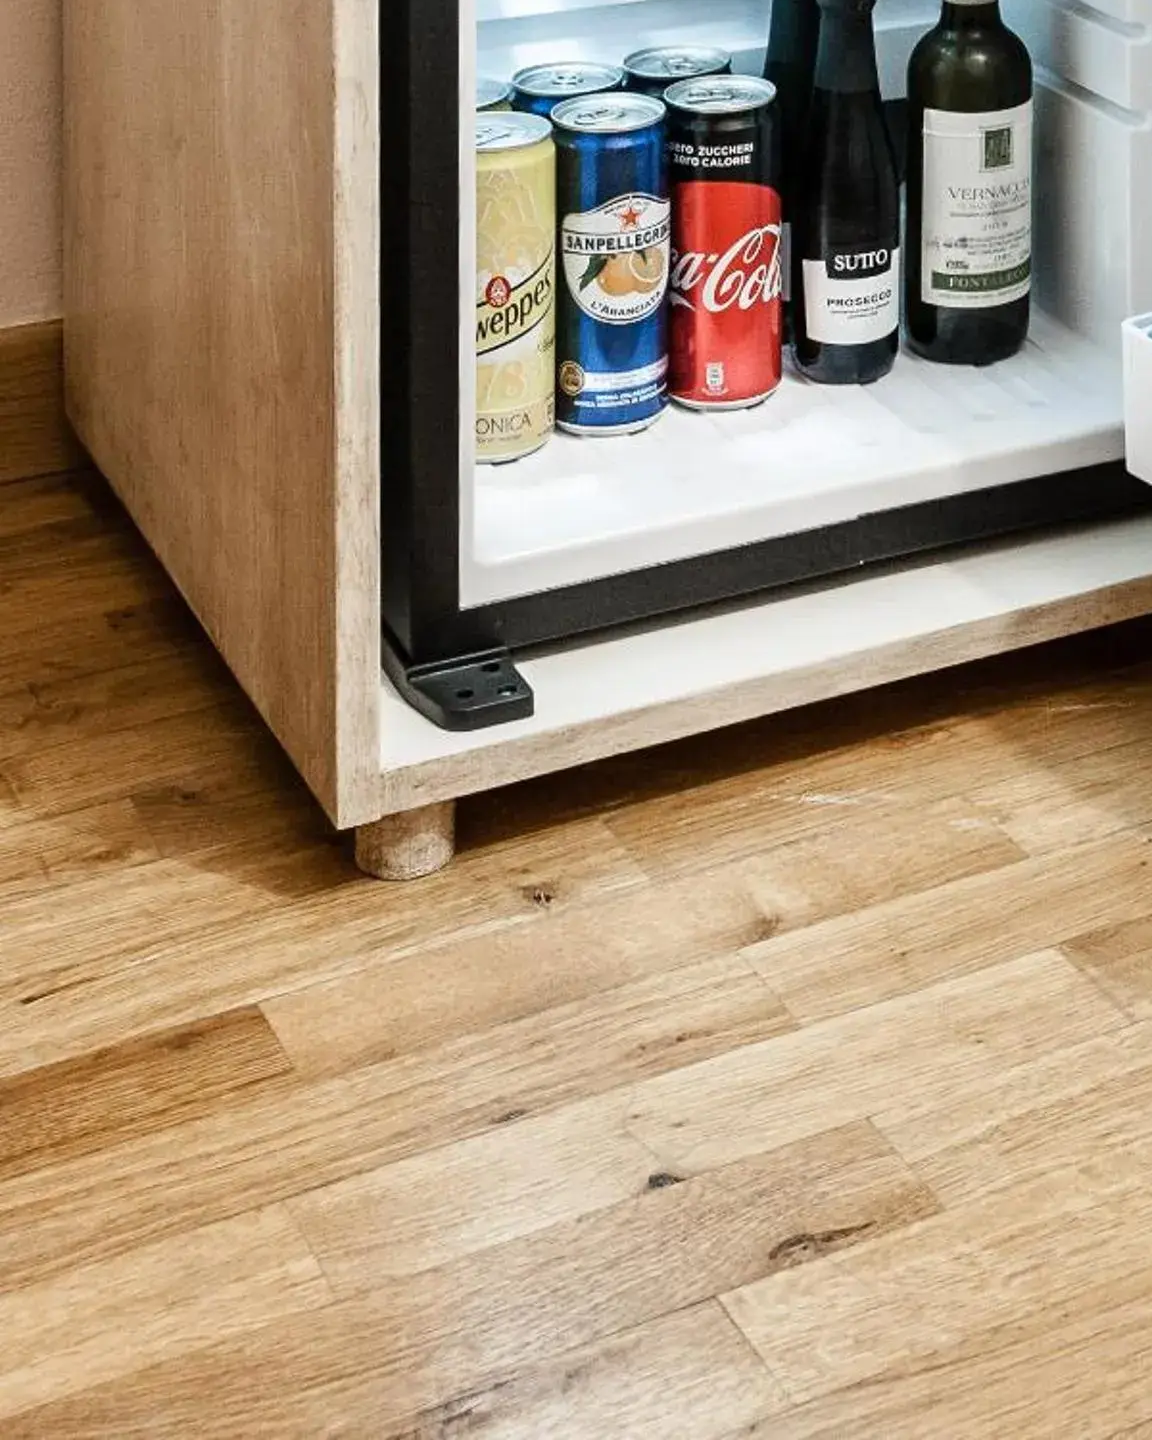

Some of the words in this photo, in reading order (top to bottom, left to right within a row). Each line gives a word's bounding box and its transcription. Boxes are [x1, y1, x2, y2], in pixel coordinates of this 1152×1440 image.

[698, 141, 754, 157] ZUCCHERI
[701, 154, 751, 168] CALORIE
[834, 248, 888, 271] SUTTO
[826, 288, 892, 307] PROSECCO
